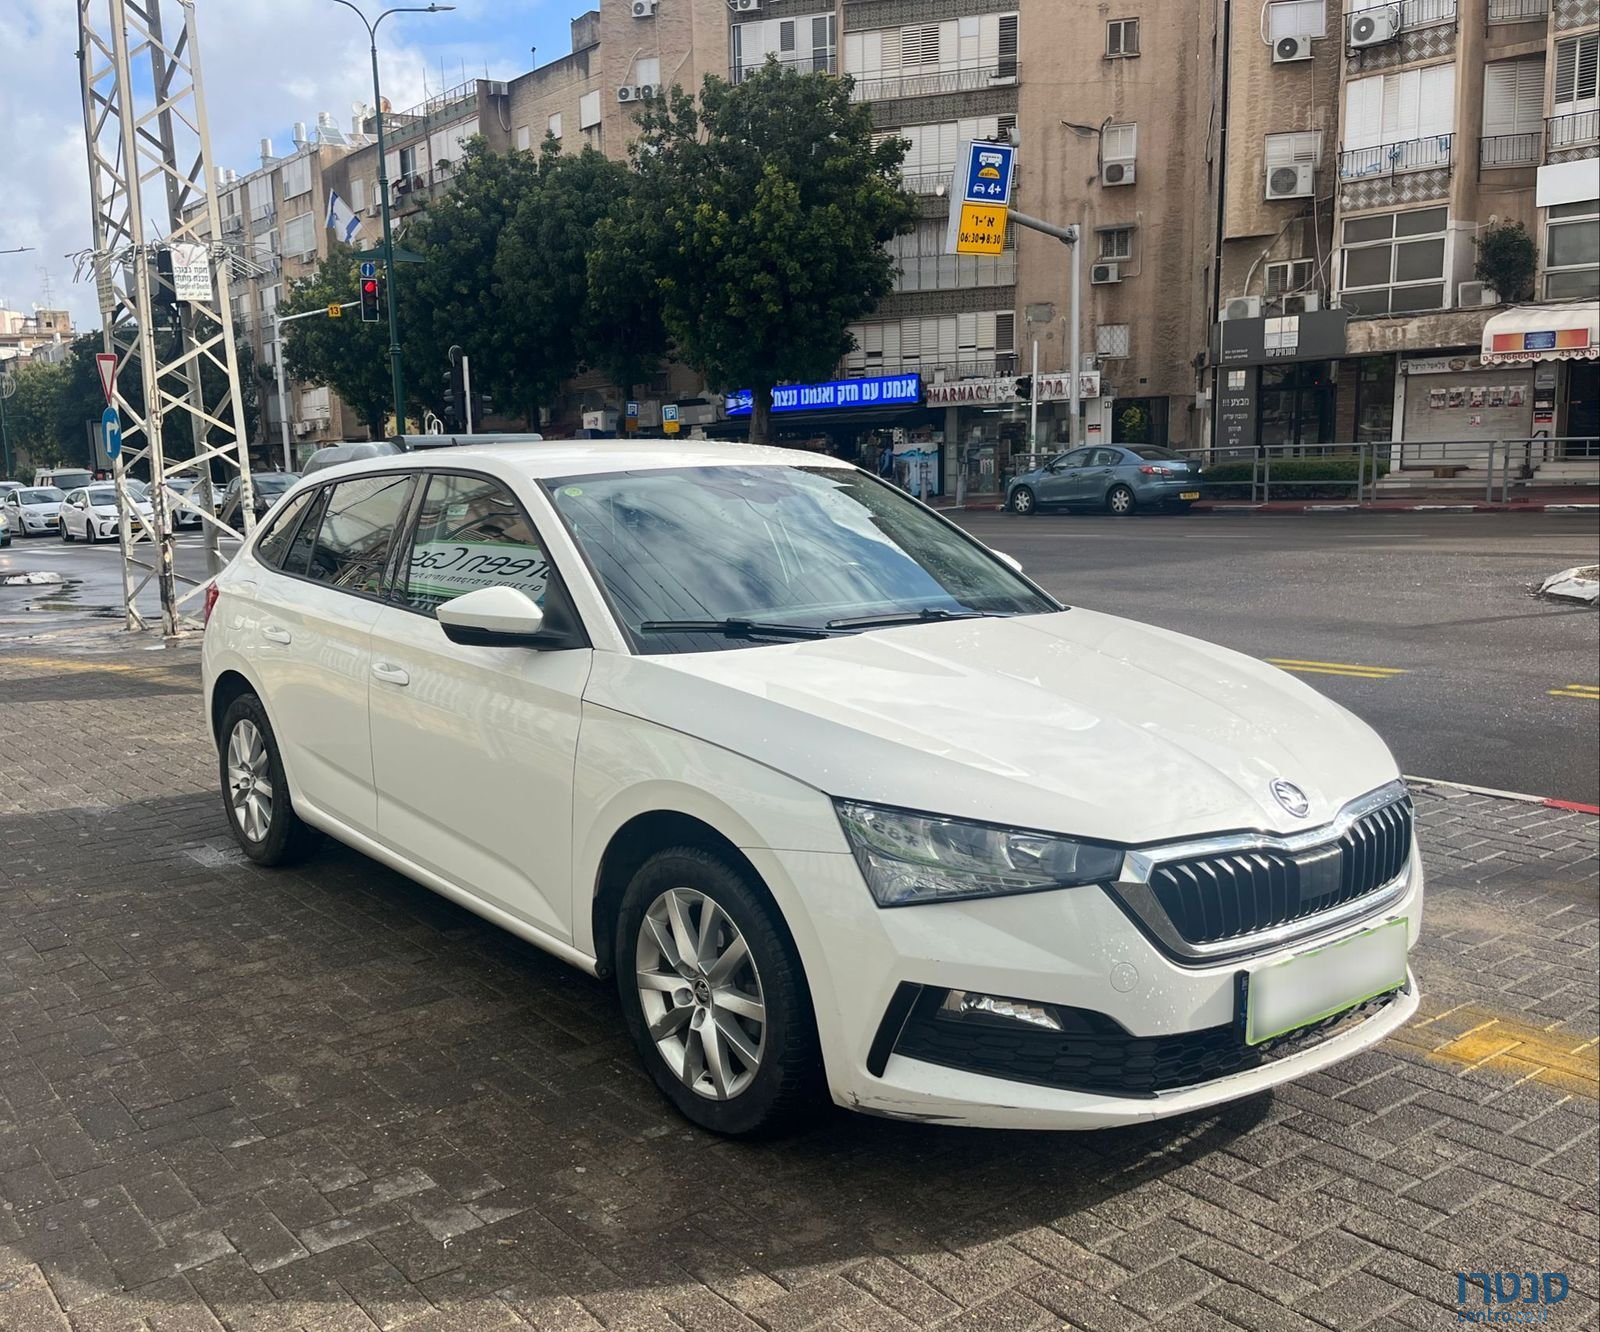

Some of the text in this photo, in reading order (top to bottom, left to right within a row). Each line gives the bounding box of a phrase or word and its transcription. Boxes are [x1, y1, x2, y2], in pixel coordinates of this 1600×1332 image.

[987, 183, 1001, 195] 4+
[330, 306, 339, 315] 13
[800, 386, 834, 404] ואנחנו
[837, 384, 859, 405] חזק
[862, 382, 879, 400] עם
[882, 379, 917, 399] אנחנו
[926, 384, 991, 401] PHARMACY
